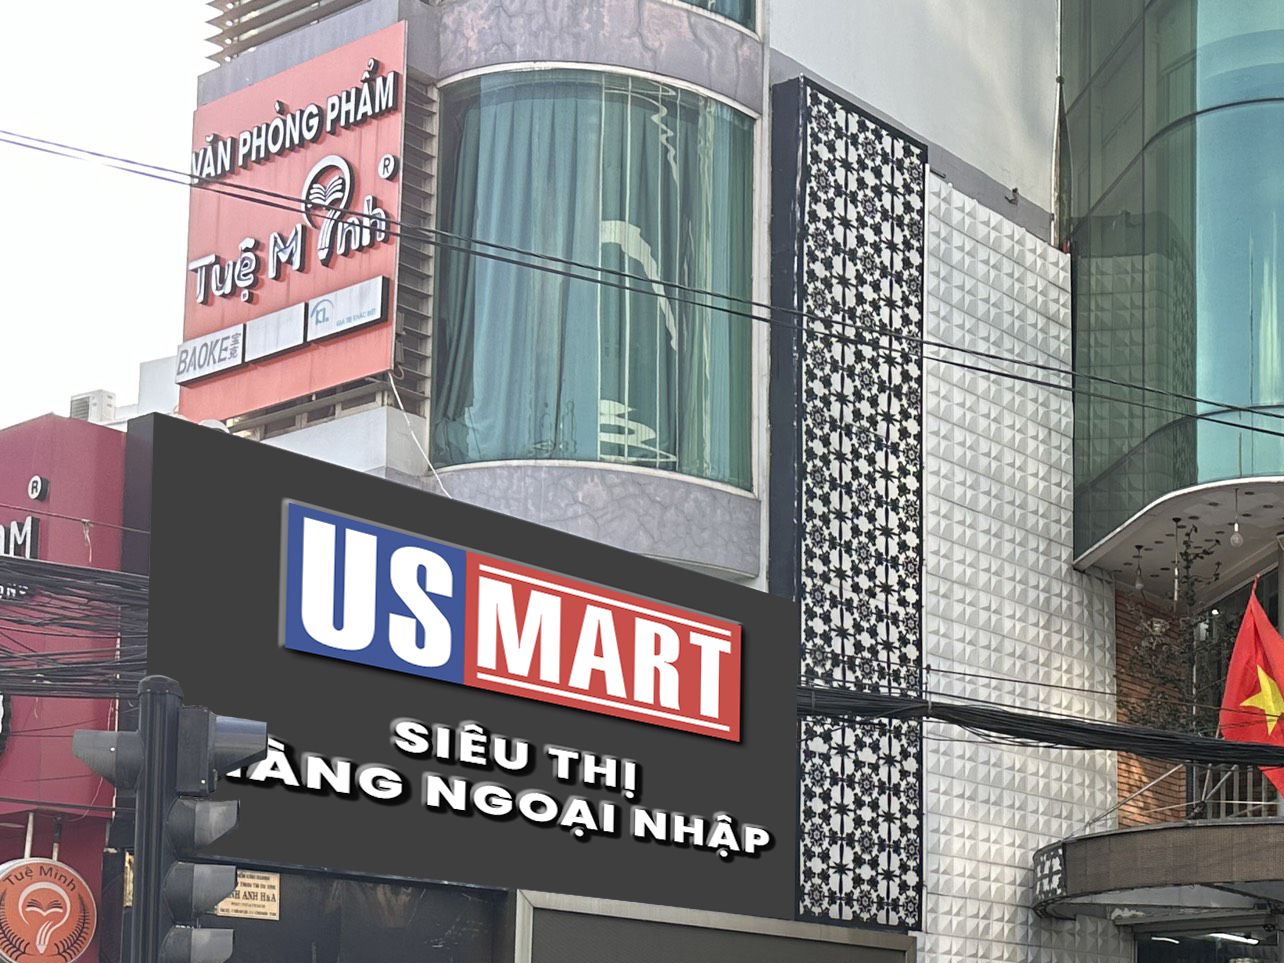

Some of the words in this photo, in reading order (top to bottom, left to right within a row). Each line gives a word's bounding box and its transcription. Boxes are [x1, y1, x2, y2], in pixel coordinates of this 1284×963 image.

[193, 134, 231, 182] VĂN
[238, 101, 320, 166] PHÒNG
[326, 58, 394, 132] PHẨM
[189, 238, 256, 302] Tuệ
[176, 336, 230, 376] BAOKE
[301, 516, 453, 668] US
[476, 576, 732, 719] MART
[226, 734, 403, 799] ÀNG
[424, 774, 615, 837] NGOẠI
[631, 806, 771, 858] NHẬP
[391, 719, 529, 771] SIÊU
[546, 745, 637, 799] THỊ
[5, 867, 33, 886] Tuệ
[40, 866, 76, 892] Minh
